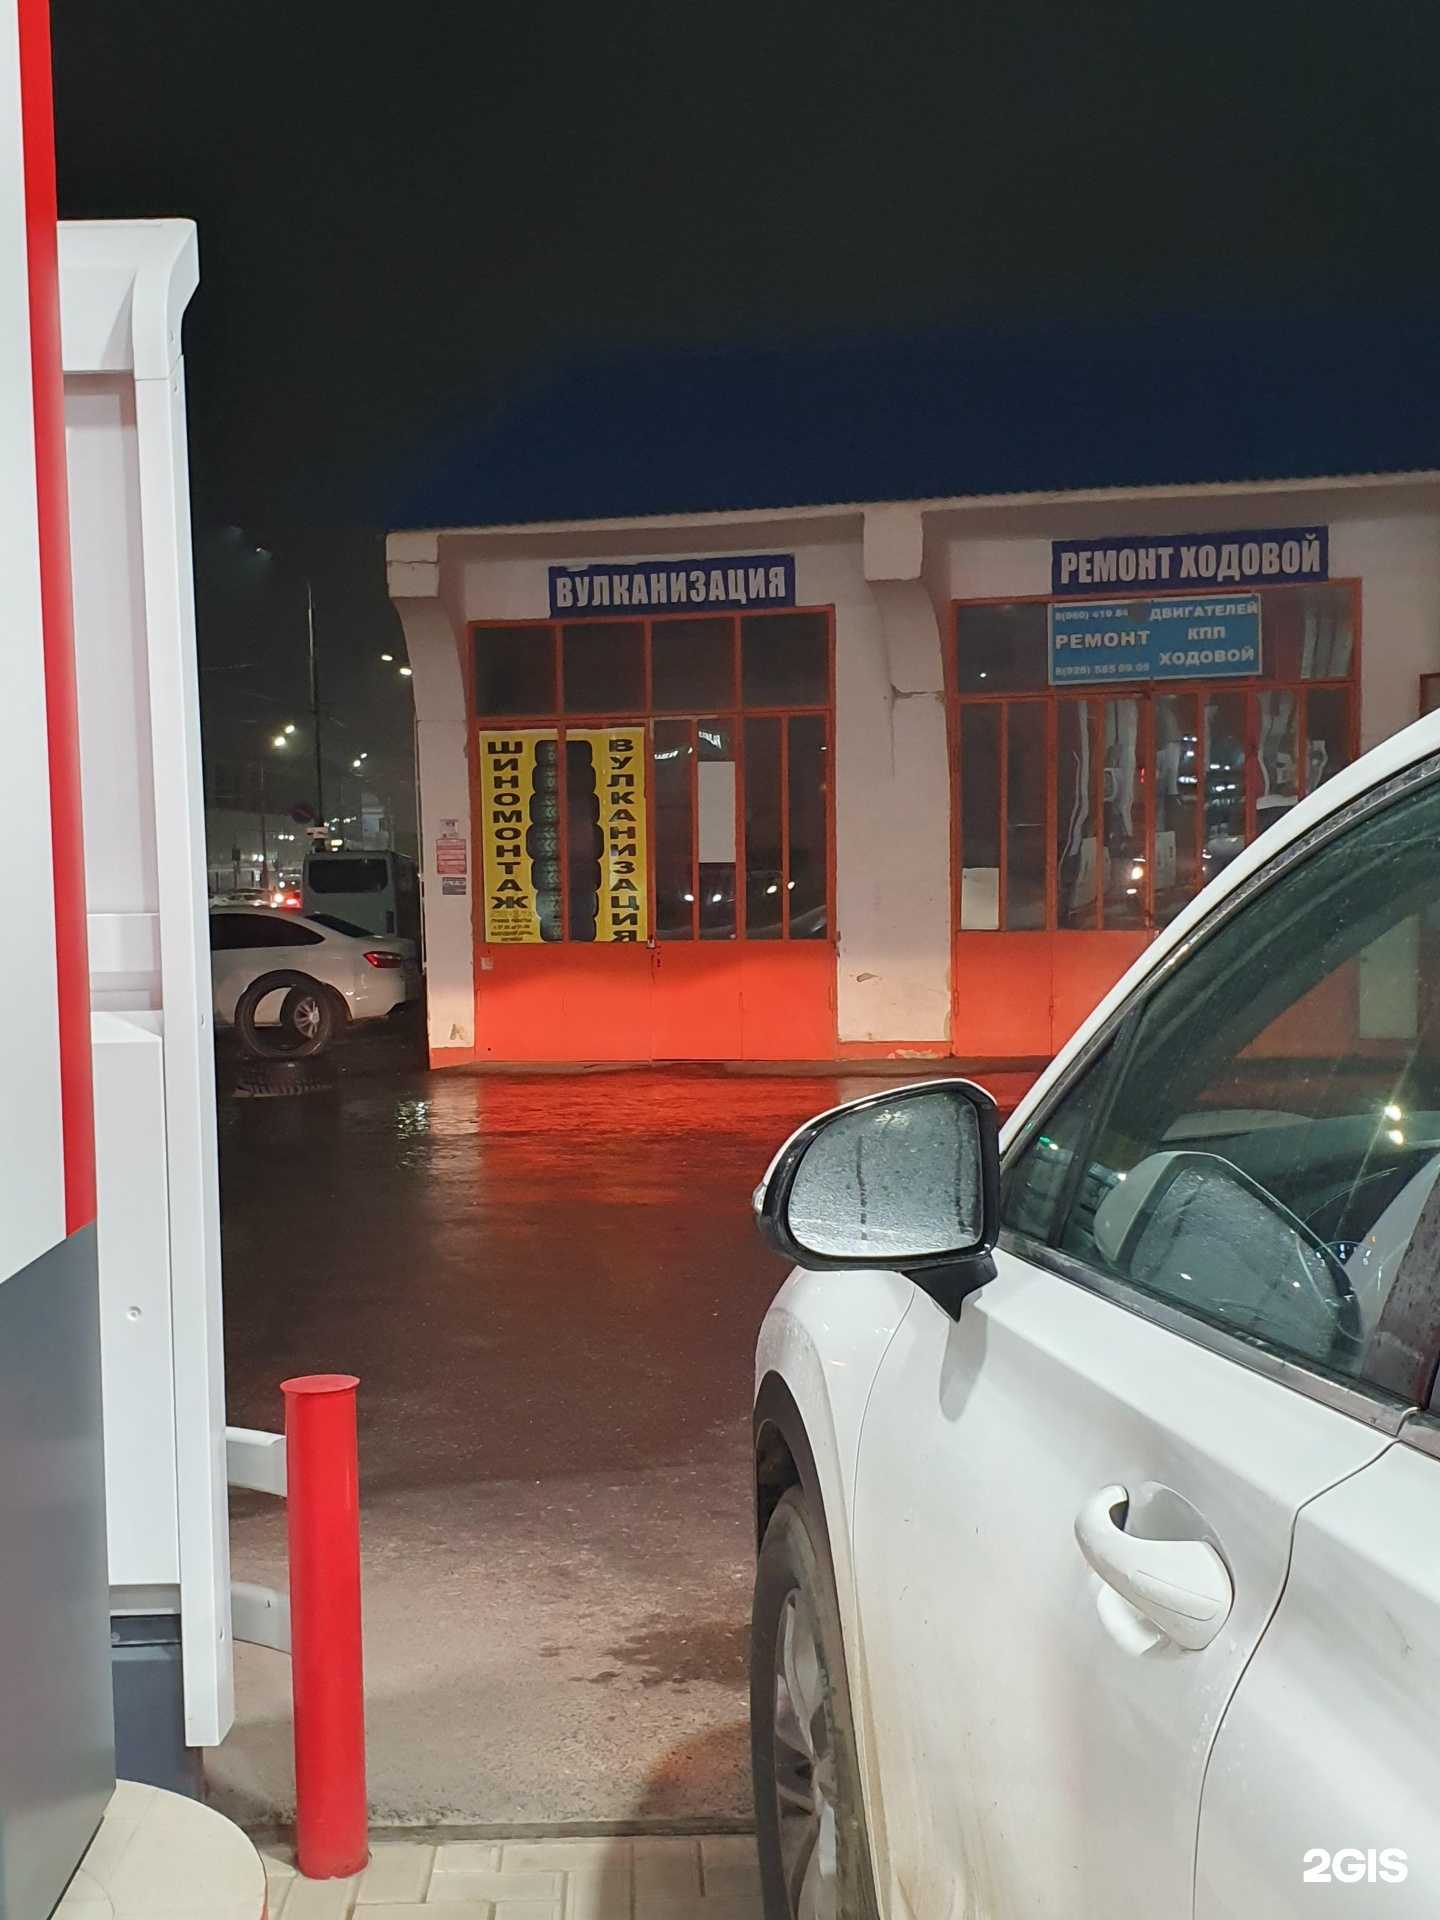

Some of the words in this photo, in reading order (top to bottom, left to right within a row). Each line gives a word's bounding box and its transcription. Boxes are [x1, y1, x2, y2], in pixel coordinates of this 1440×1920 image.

[1060, 547, 1174, 584] РЕМОНТ
[1180, 533, 1321, 582] ХОДОВОЙ
[556, 566, 785, 608] ВУЛКАНИЗАЦИЯ
[1150, 601, 1258, 621] ДВИГАТЕЛЕЙ
[1055, 630, 1150, 649] РЕМОНТ
[1187, 626, 1226, 641] КПП
[1159, 646, 1254, 667] ХОДОВОЙ
[487, 741, 528, 909] ШИНОМОНТАЖ
[607, 739, 640, 942] ВУЛКАНИЗАЦИЯ
